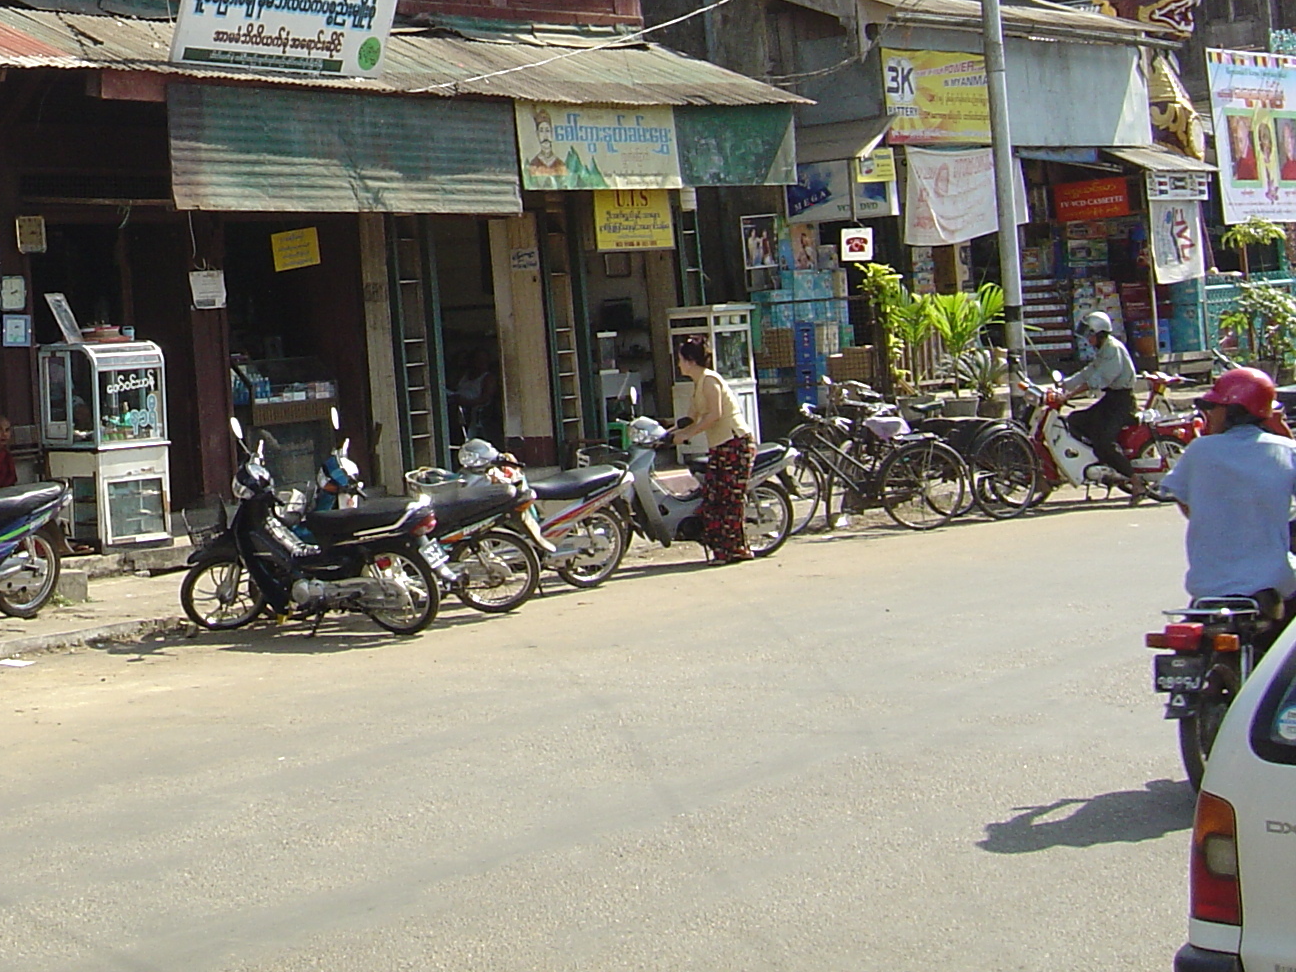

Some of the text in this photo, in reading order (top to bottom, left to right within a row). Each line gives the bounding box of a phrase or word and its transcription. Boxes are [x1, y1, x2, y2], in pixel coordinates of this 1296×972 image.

[887, 65, 914, 95] 3K
[950, 74, 988, 86] MYANMA
[793, 189, 826, 212] MEGA
